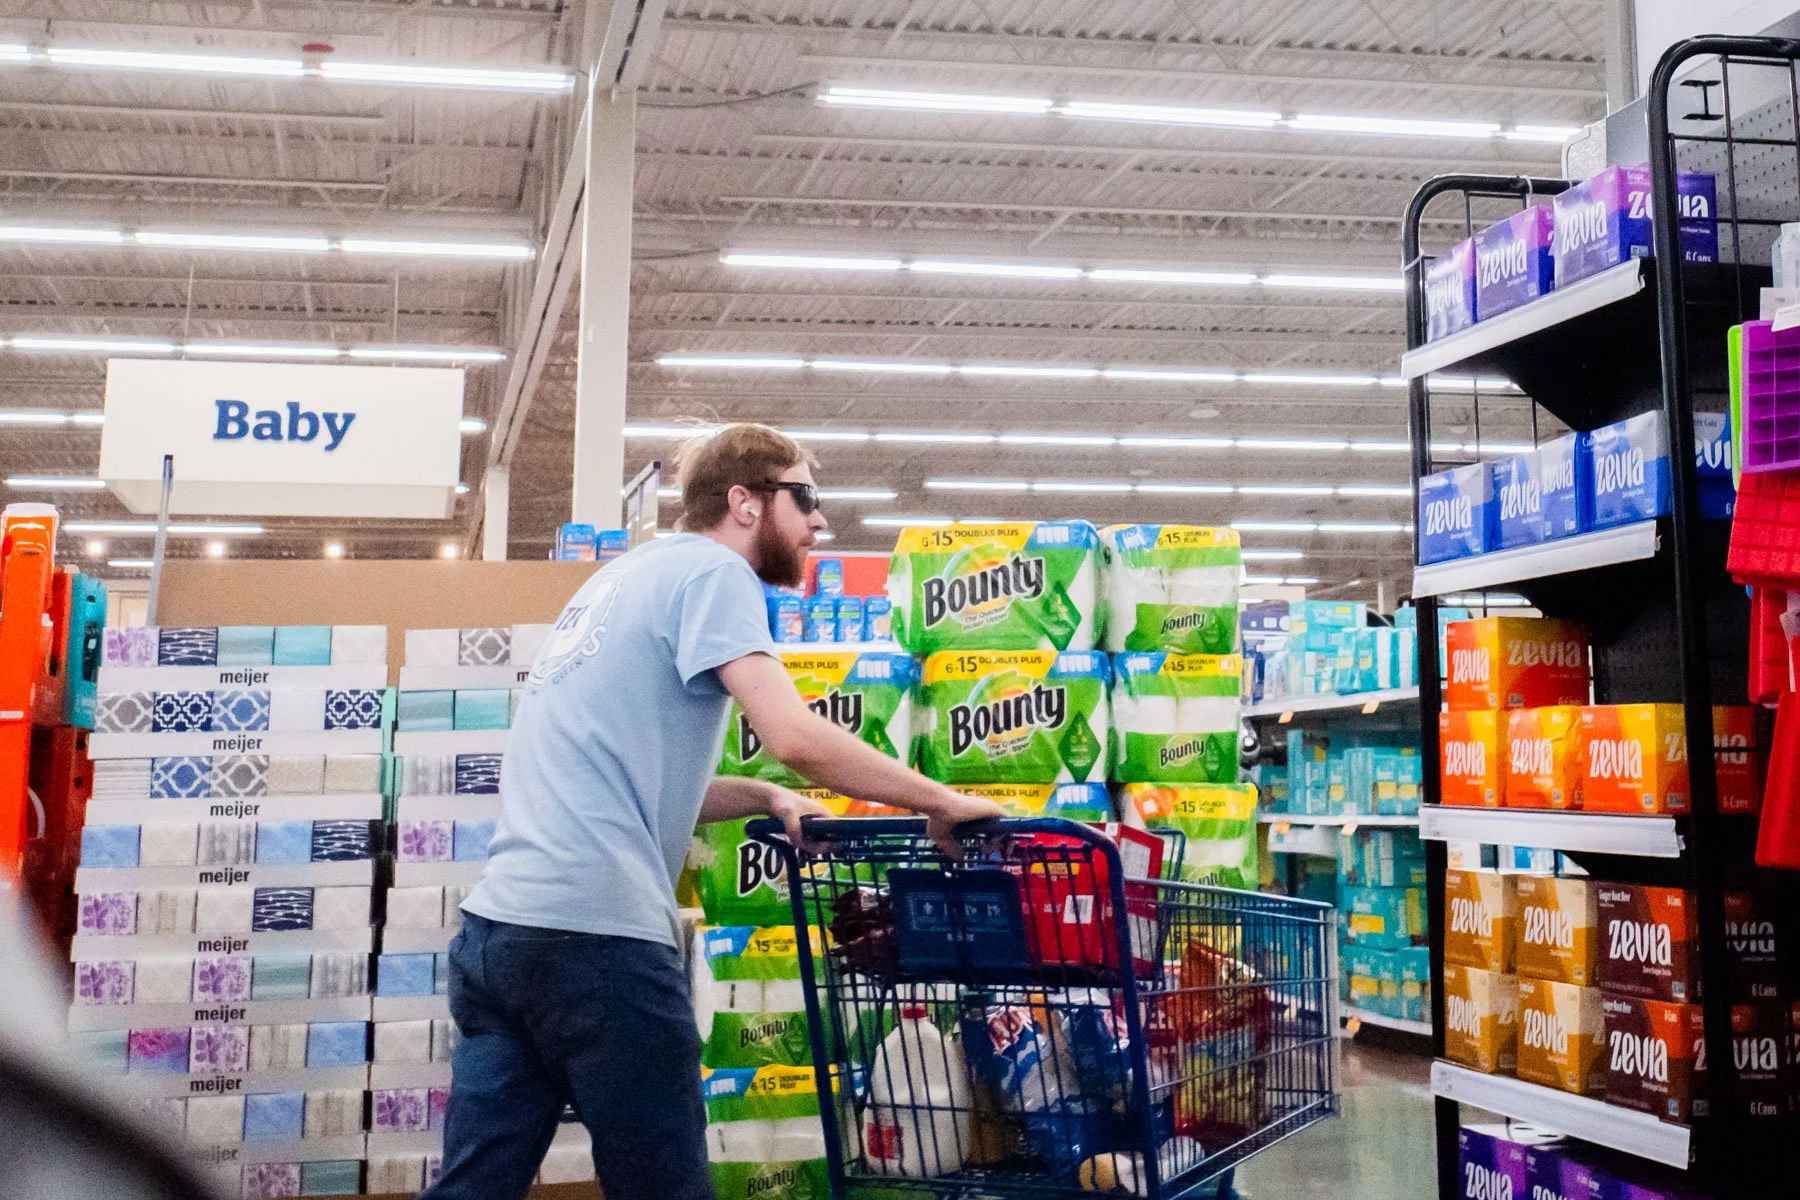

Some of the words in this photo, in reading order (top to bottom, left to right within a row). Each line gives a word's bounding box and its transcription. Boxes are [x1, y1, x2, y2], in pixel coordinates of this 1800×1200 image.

[213, 400, 356, 450] Baby
[924, 556, 1043, 626] Bounty
[219, 670, 268, 686] meijer
[950, 684, 1064, 756] Bounty
[212, 736, 262, 752] meijer
[1160, 740, 1204, 766] Bounty
[210, 802, 260, 818] meijer
[199, 868, 250, 884] meijer
[197, 937, 248, 953] meijer
[1609, 920, 1672, 966] zevia
[194, 1006, 246, 1022] meijer
[1610, 1030, 1668, 1082] zevia
[190, 1076, 242, 1092] meijer
